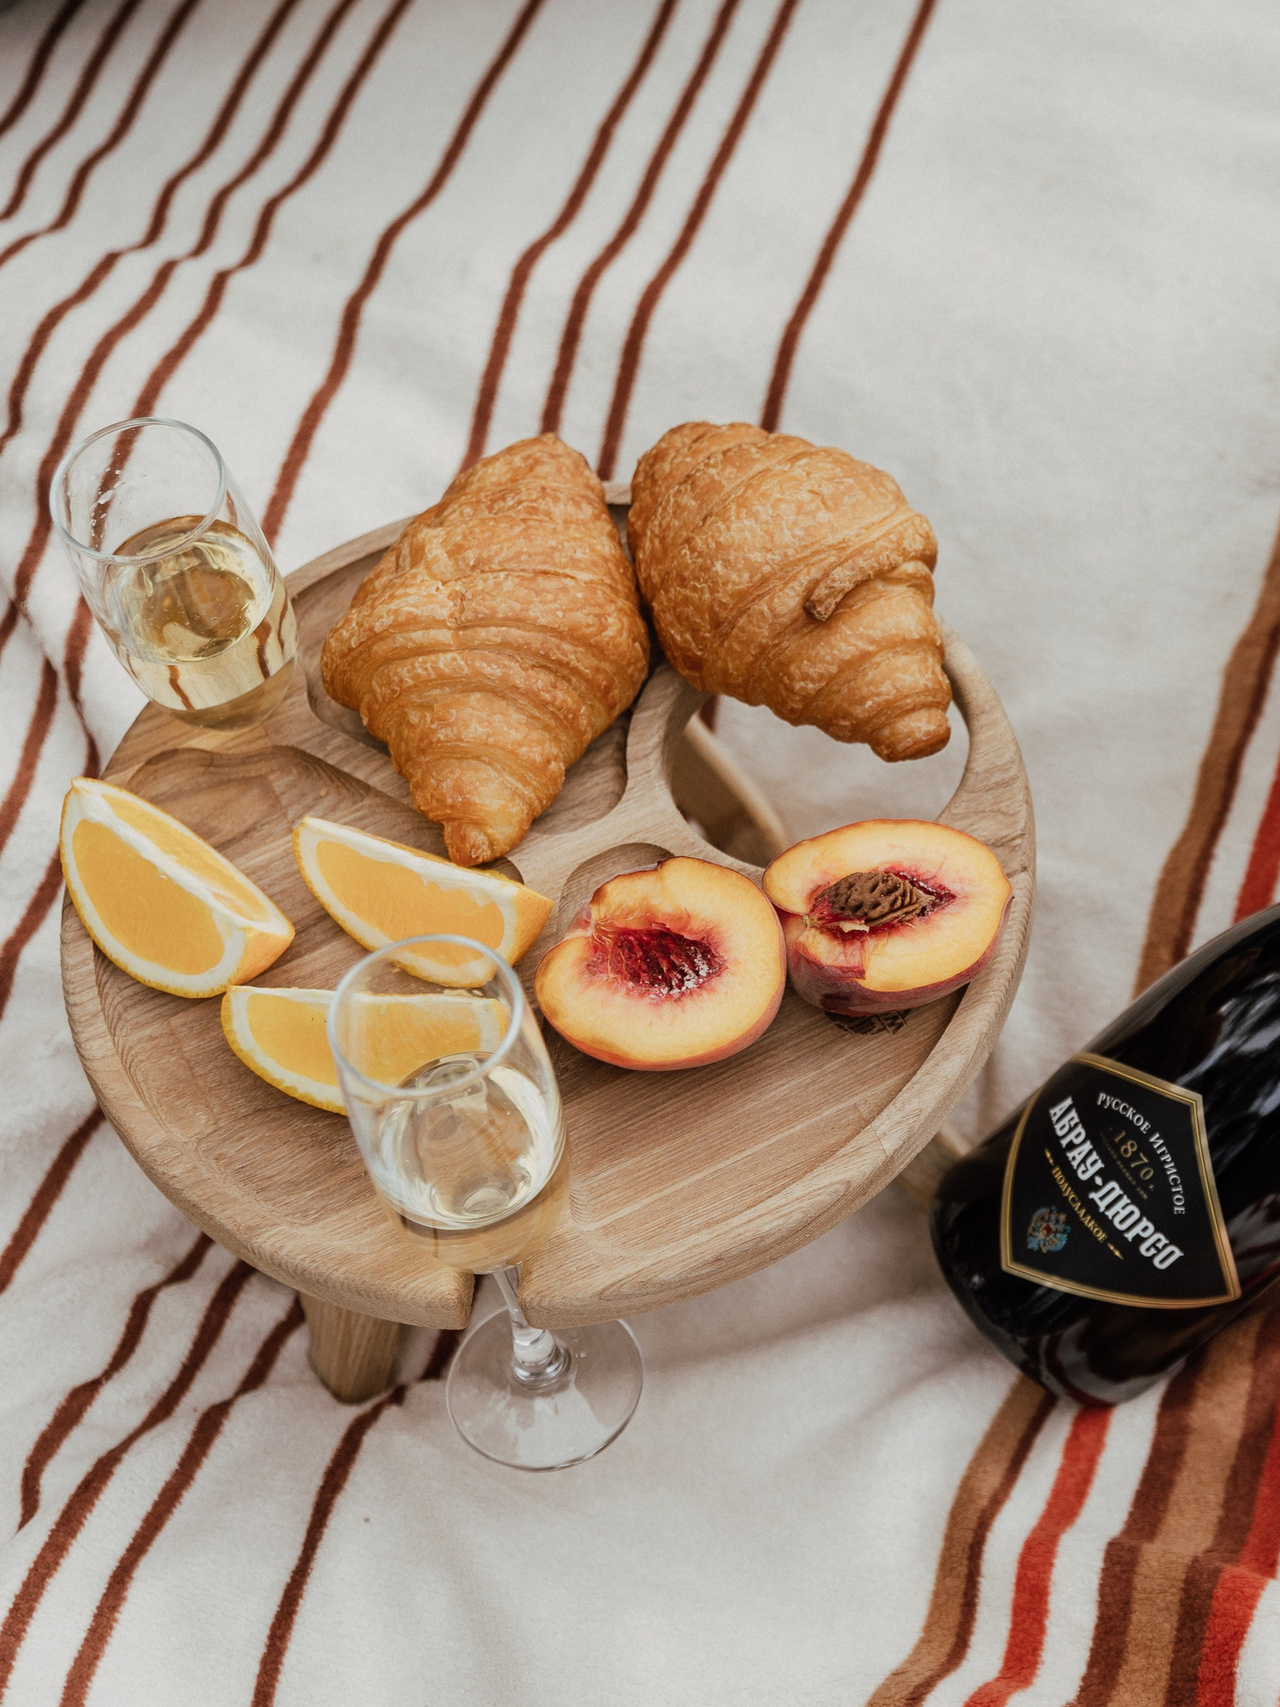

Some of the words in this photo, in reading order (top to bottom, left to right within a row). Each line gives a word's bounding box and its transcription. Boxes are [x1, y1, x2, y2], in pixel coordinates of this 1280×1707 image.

[1096, 1091, 1151, 1134] РУССКОЕ
[1149, 1132, 1186, 1215] ИГРИСТОЕ
[1114, 1130, 1154, 1180] 1870
[1051, 1166, 1108, 1244] ПОЛУСЛАДКОЕ
